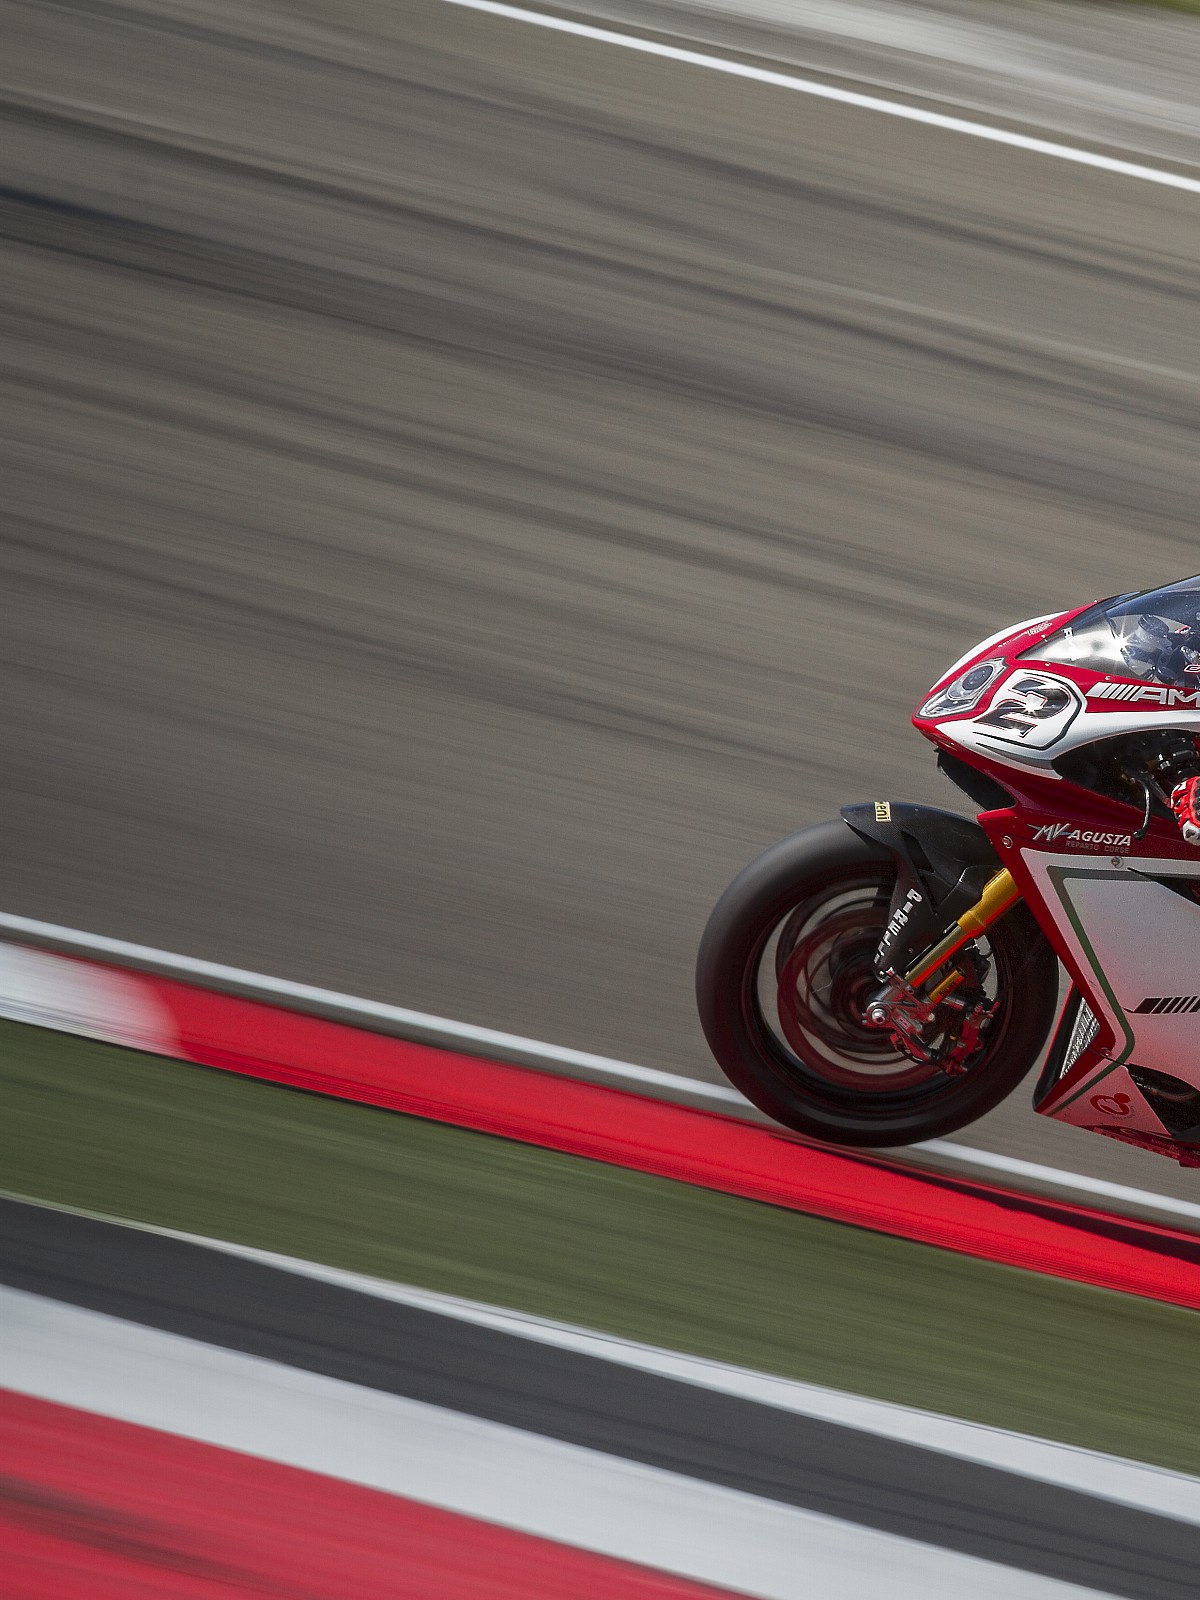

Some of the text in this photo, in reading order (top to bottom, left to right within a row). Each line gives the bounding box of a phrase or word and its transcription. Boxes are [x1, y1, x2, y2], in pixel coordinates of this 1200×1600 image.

[971, 676, 1073, 739] 2
[1065, 840, 1130, 854] REPARTO CORSE
[1067, 829, 1132, 847] AGUSTA
[873, 888, 923, 964] PIRELLI
